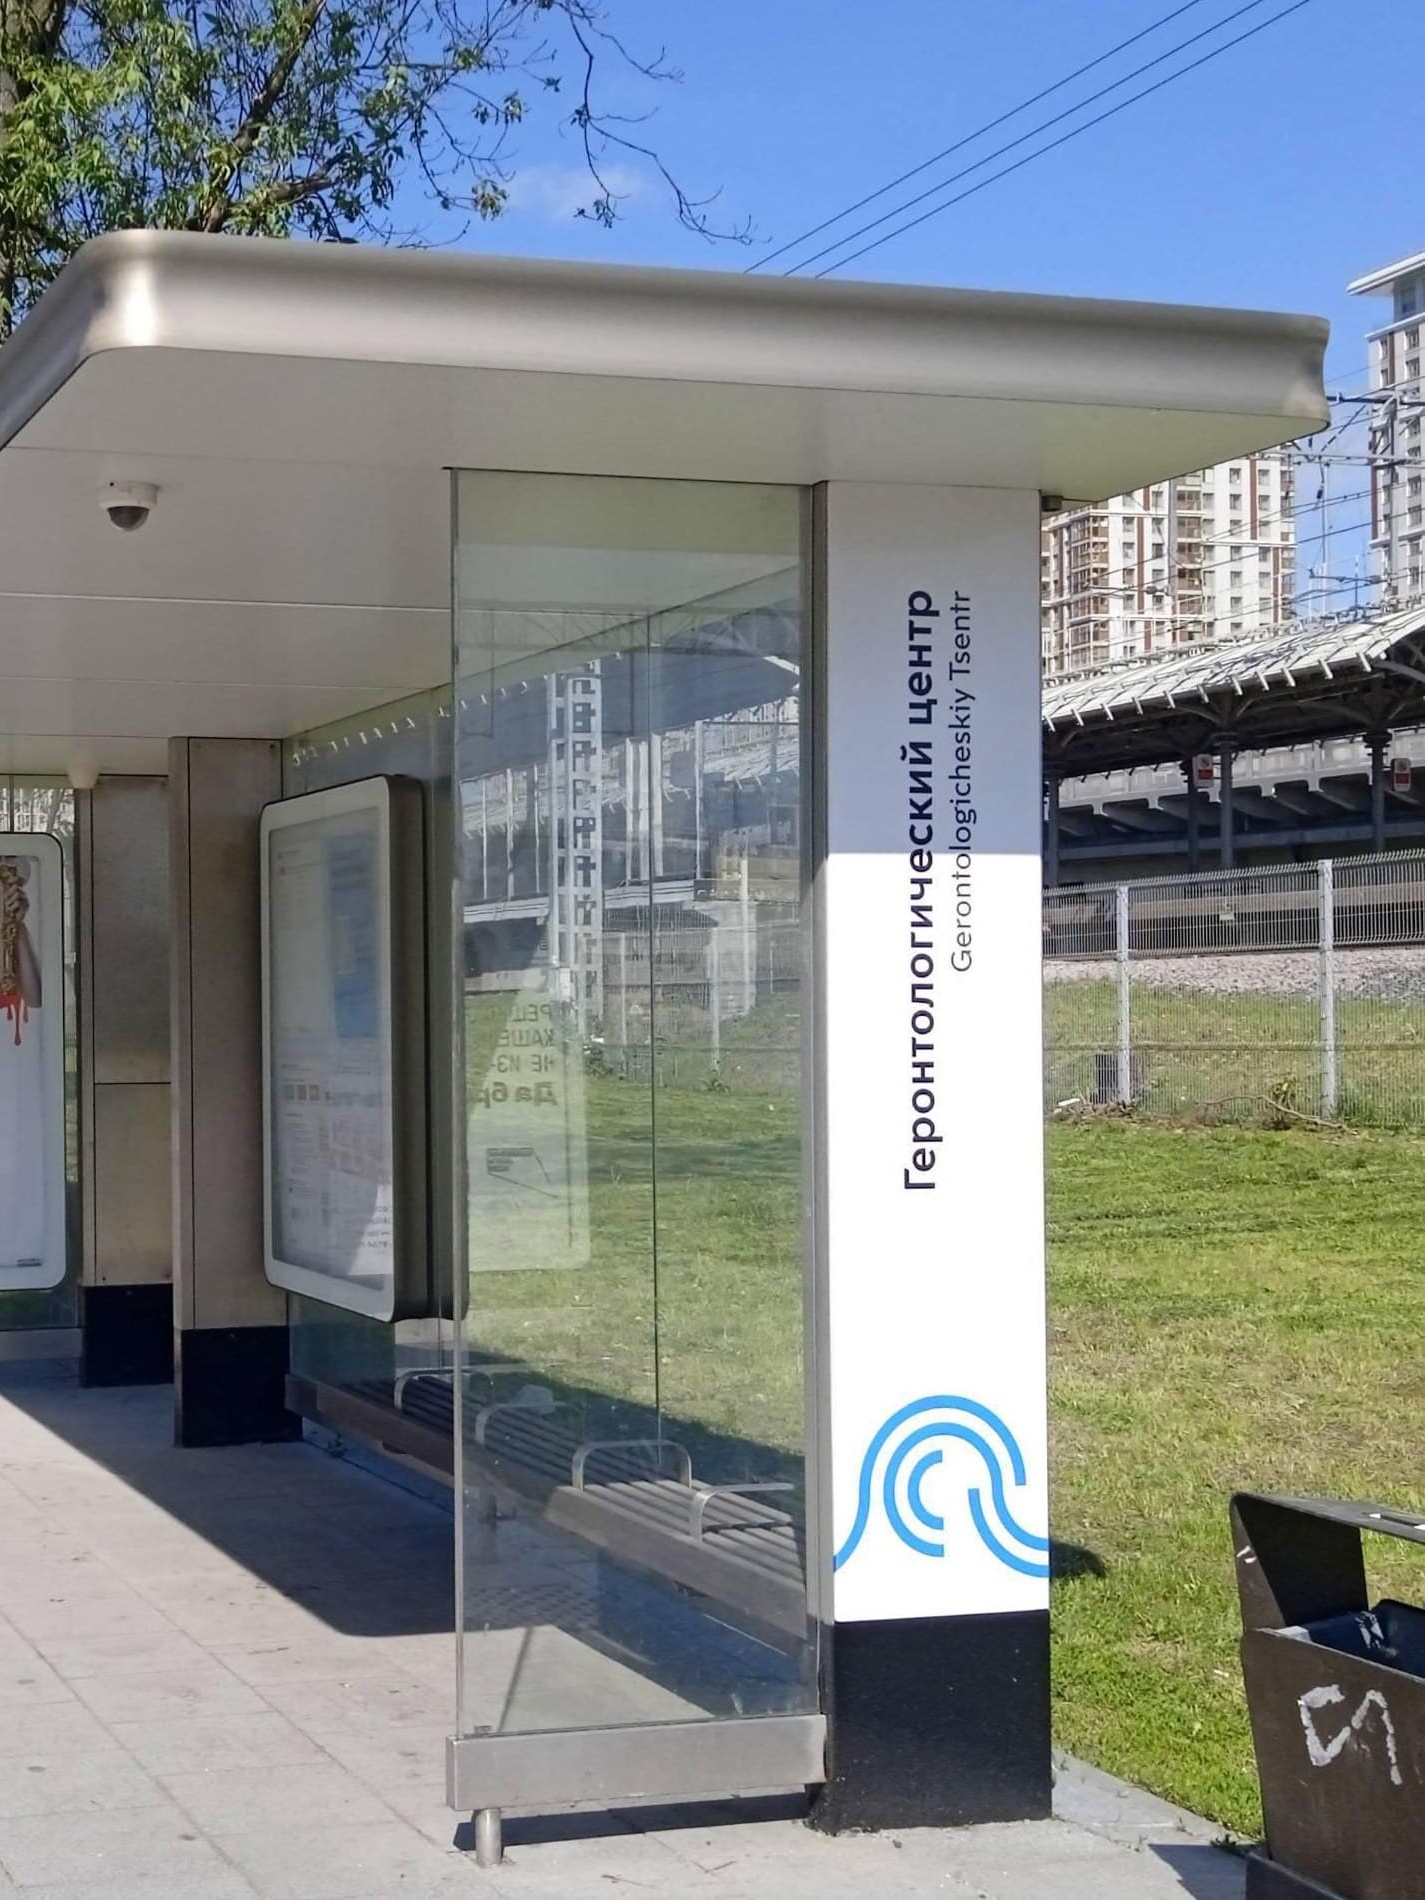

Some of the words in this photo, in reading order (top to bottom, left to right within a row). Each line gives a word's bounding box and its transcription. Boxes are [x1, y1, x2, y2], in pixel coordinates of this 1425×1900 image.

[907, 589, 941, 725] центр
[948, 590, 973, 681] Tsentr
[948, 688, 977, 973] Gerontologicheskiy
[900, 738, 944, 1191] Геронтологический
